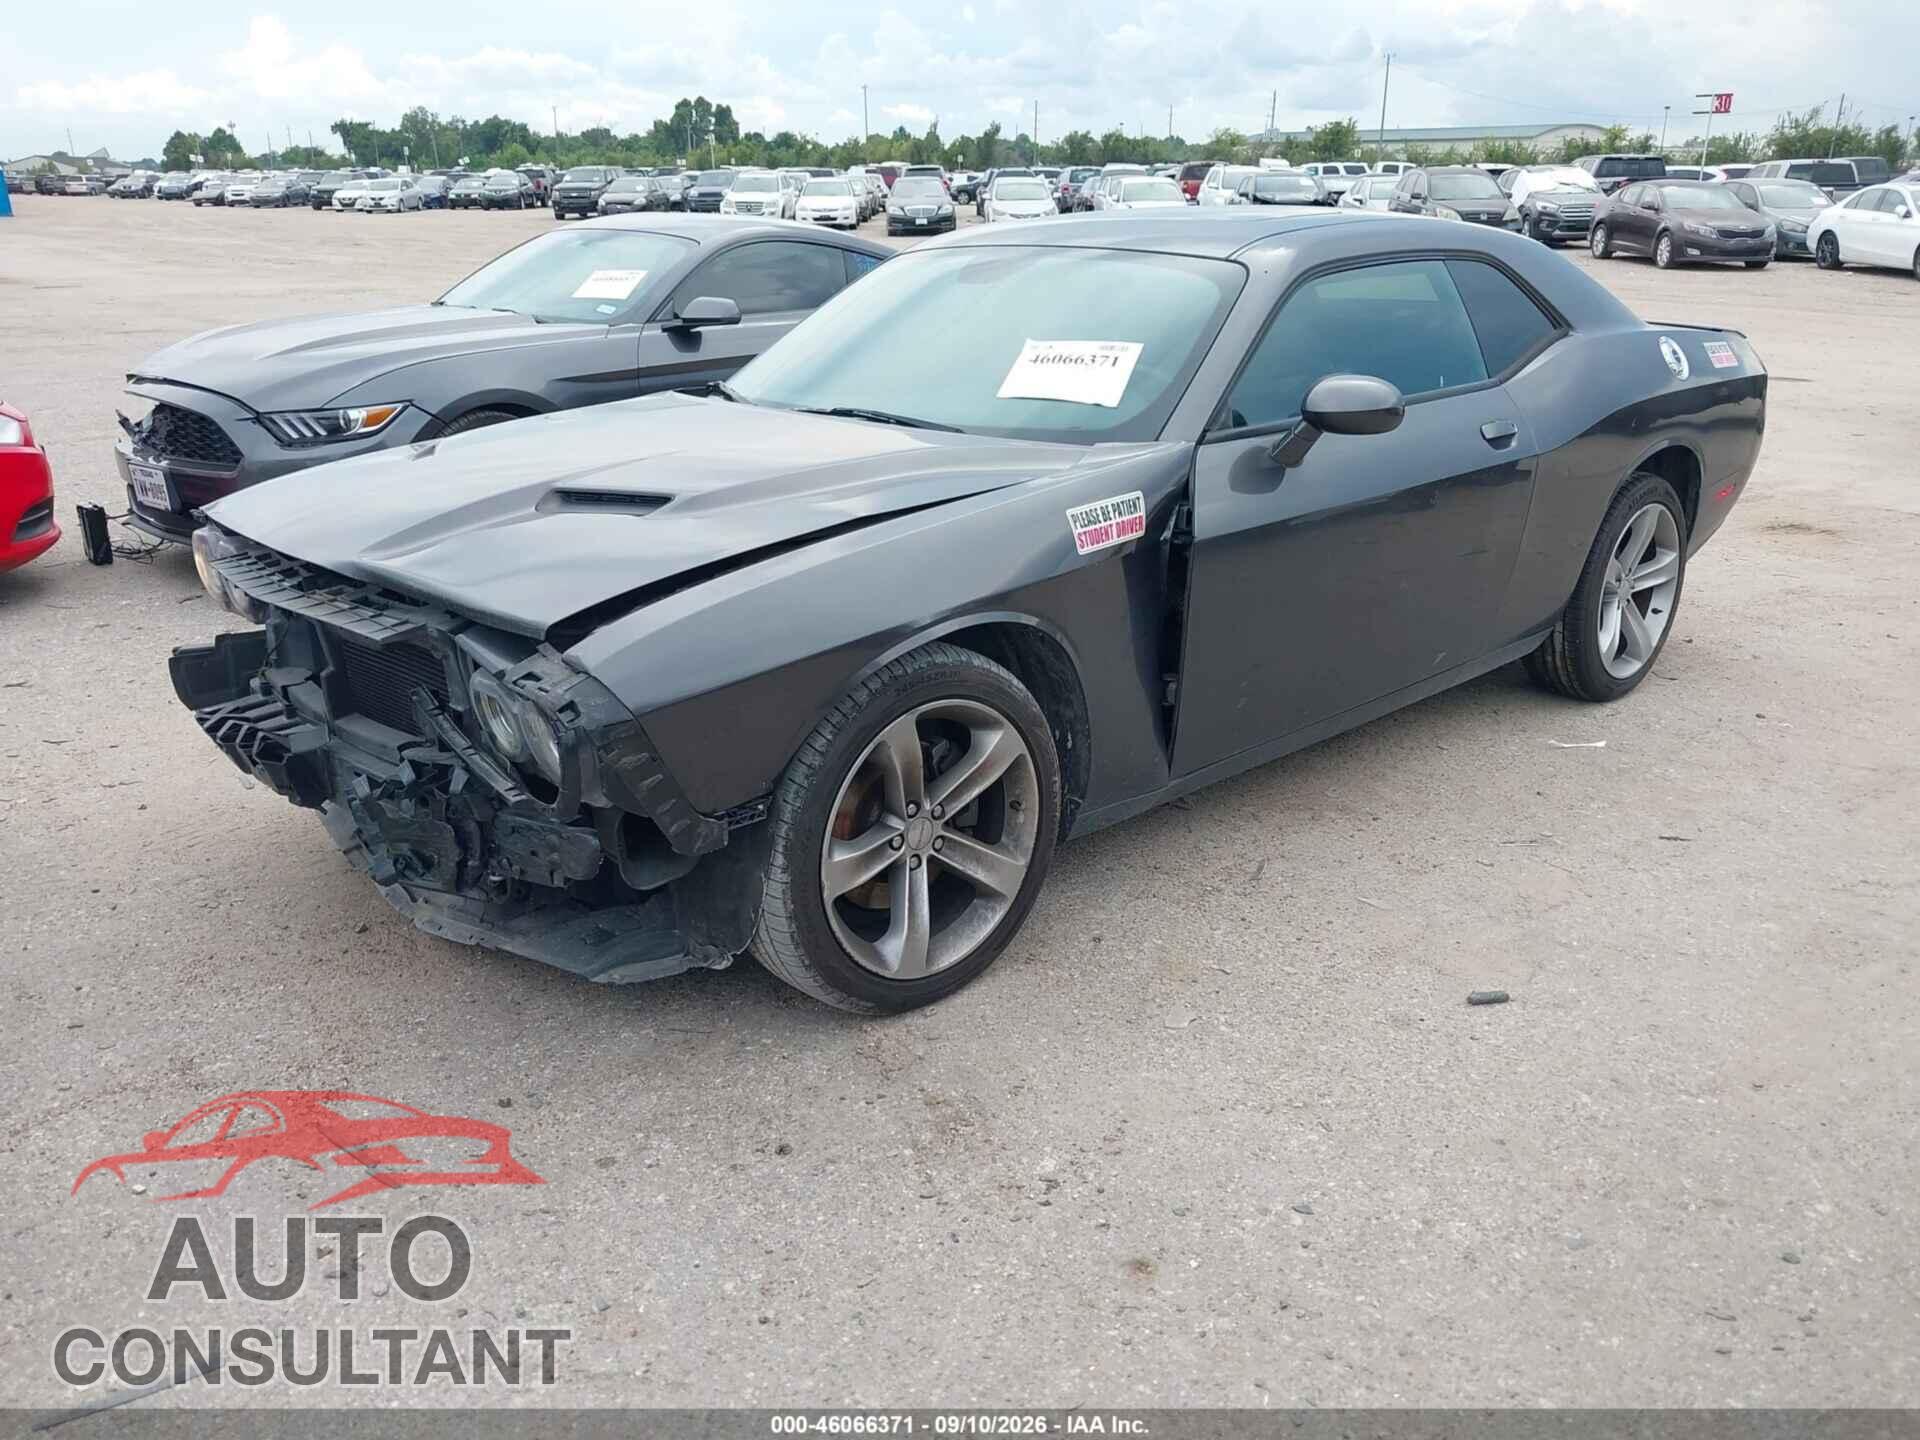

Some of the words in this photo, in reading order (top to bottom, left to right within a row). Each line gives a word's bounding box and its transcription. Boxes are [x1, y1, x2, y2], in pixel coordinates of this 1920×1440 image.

[1715, 95, 1732, 112] 30
[1028, 353, 1120, 368] 46066371
[1070, 506, 1101, 530] PLEASE
[1099, 504, 1112, 522] BE
[1111, 496, 1142, 520] PATIENT
[1077, 522, 1115, 549] STUDENT
[1115, 514, 1144, 539] DRIVER
